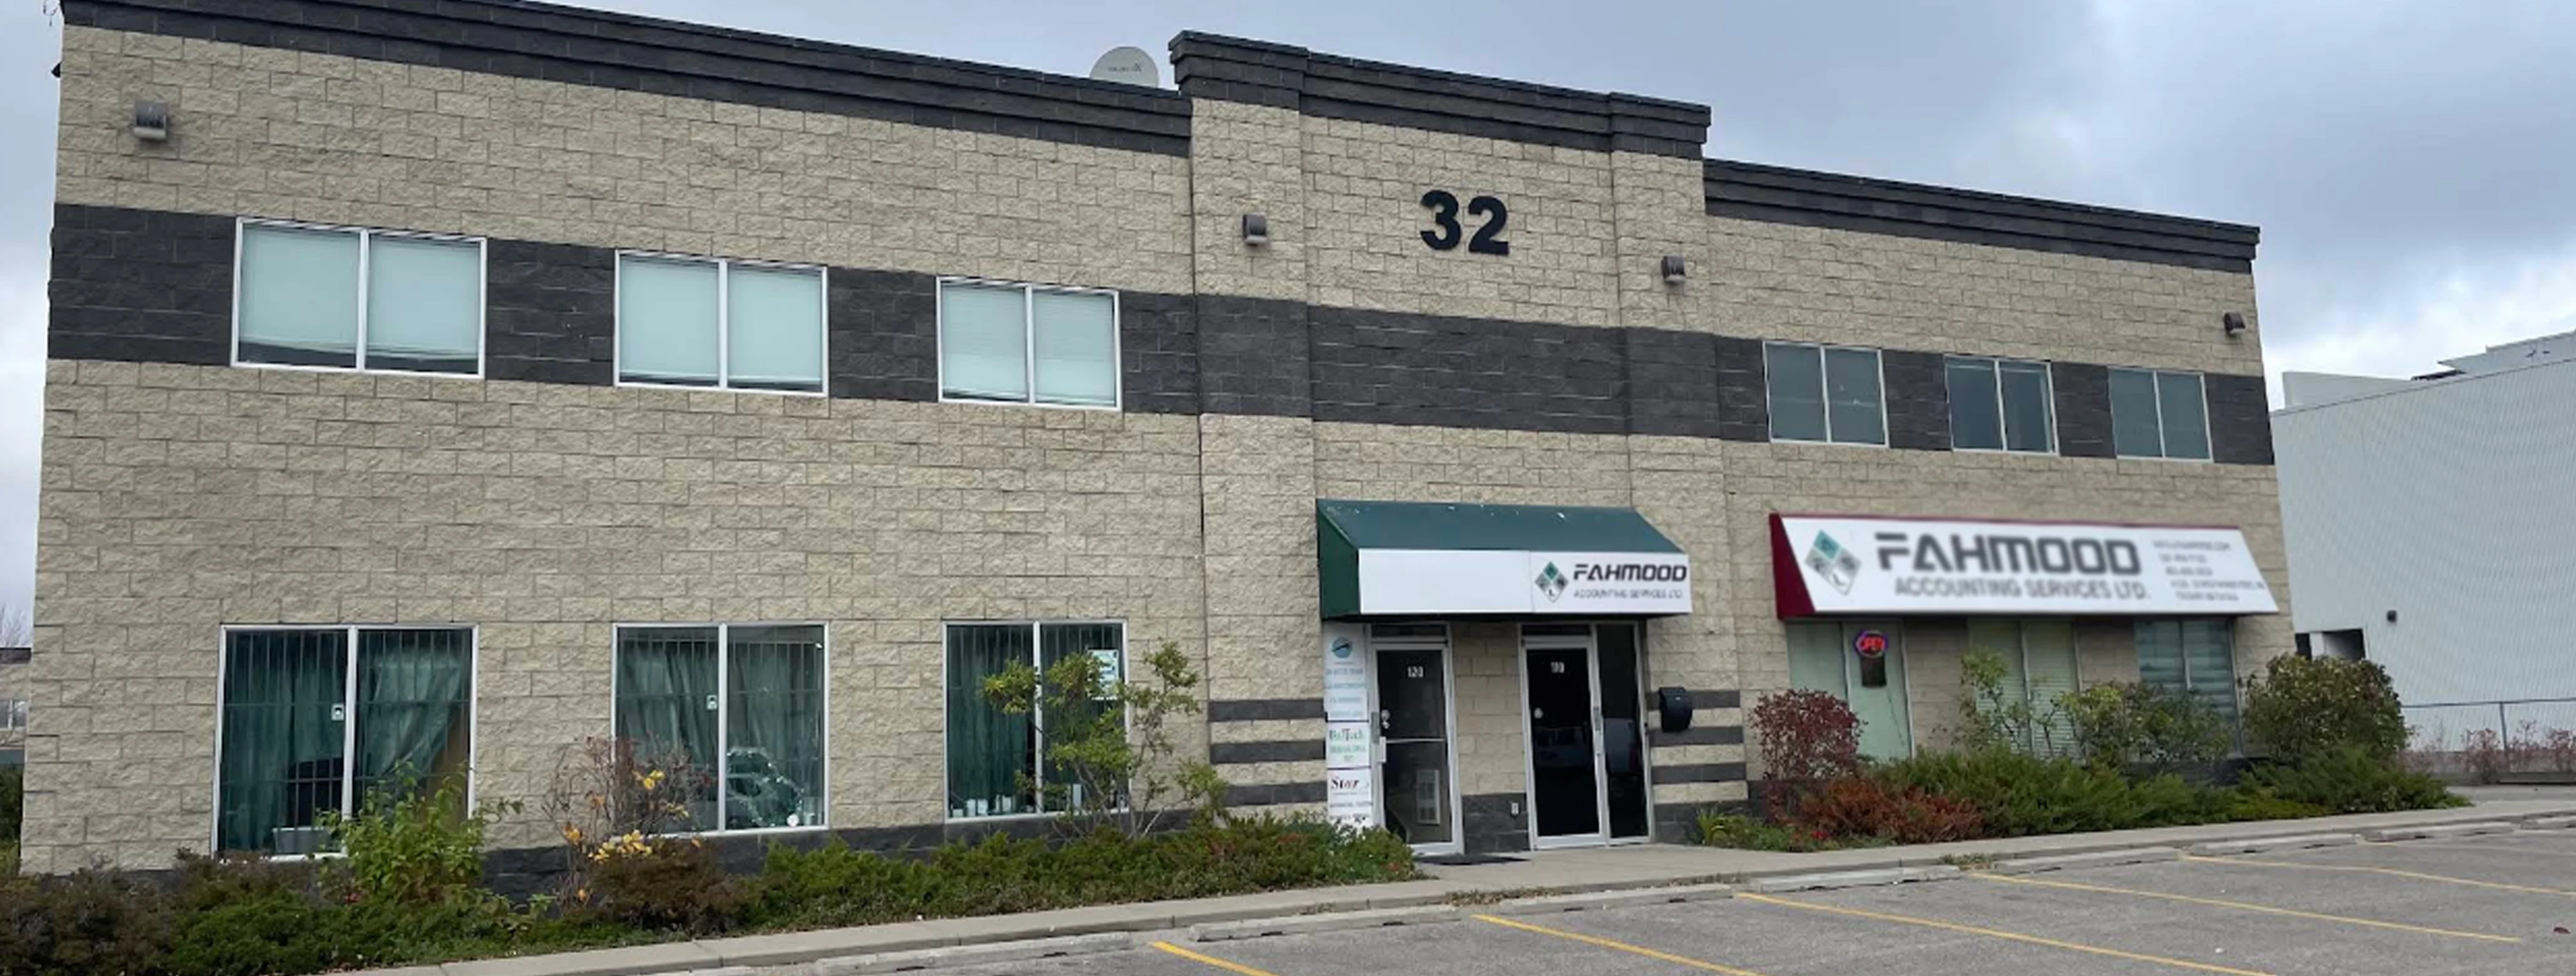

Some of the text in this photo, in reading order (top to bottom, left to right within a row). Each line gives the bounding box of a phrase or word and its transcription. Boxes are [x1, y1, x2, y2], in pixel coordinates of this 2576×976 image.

[1420, 189, 1510, 255] 32
[1875, 532, 2142, 576] FAHMOOD
[1573, 563, 1687, 581] FAHMOOD
[1895, 577, 2022, 598] ACCOUNTING
[2024, 578, 2112, 599] SERVICES
